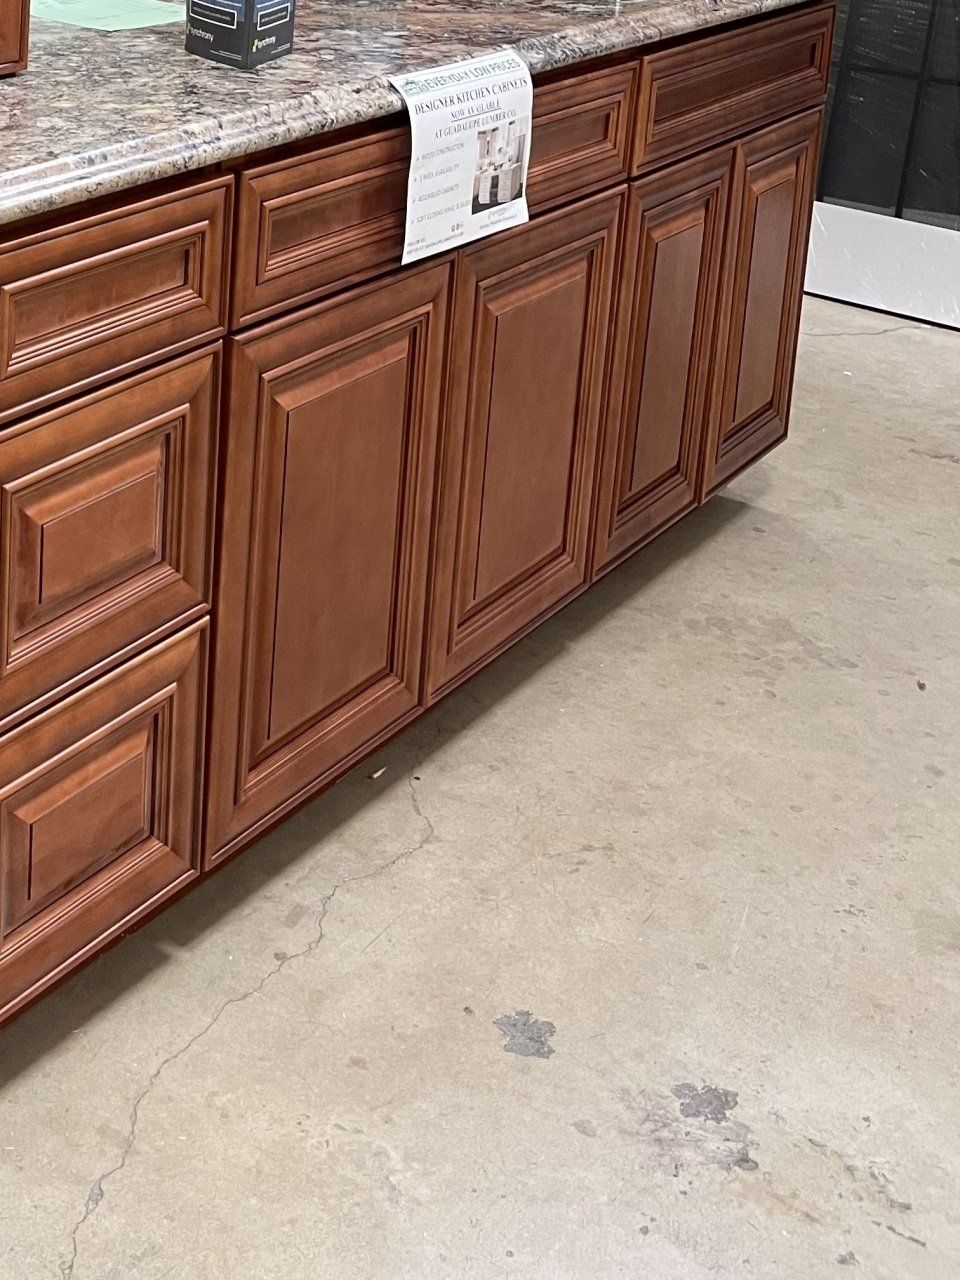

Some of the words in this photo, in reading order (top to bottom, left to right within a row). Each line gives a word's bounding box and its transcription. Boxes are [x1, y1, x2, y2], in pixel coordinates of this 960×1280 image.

[424, 70, 470, 90] EVERYDAY
[470, 65, 492, 79] LOW
[491, 58, 520, 73] PRICES
[414, 94, 456, 116] DESIGNER
[456, 86, 492, 104] KITCHEN
[492, 77, 528, 95] CABINETS
[450, 108, 465, 120] NOW
[467, 98, 502, 115] AVAILABLE
[435, 130, 442, 139] AT
[443, 118, 481, 137] GUADALUPE
[481, 111, 507, 127] LUMBER
